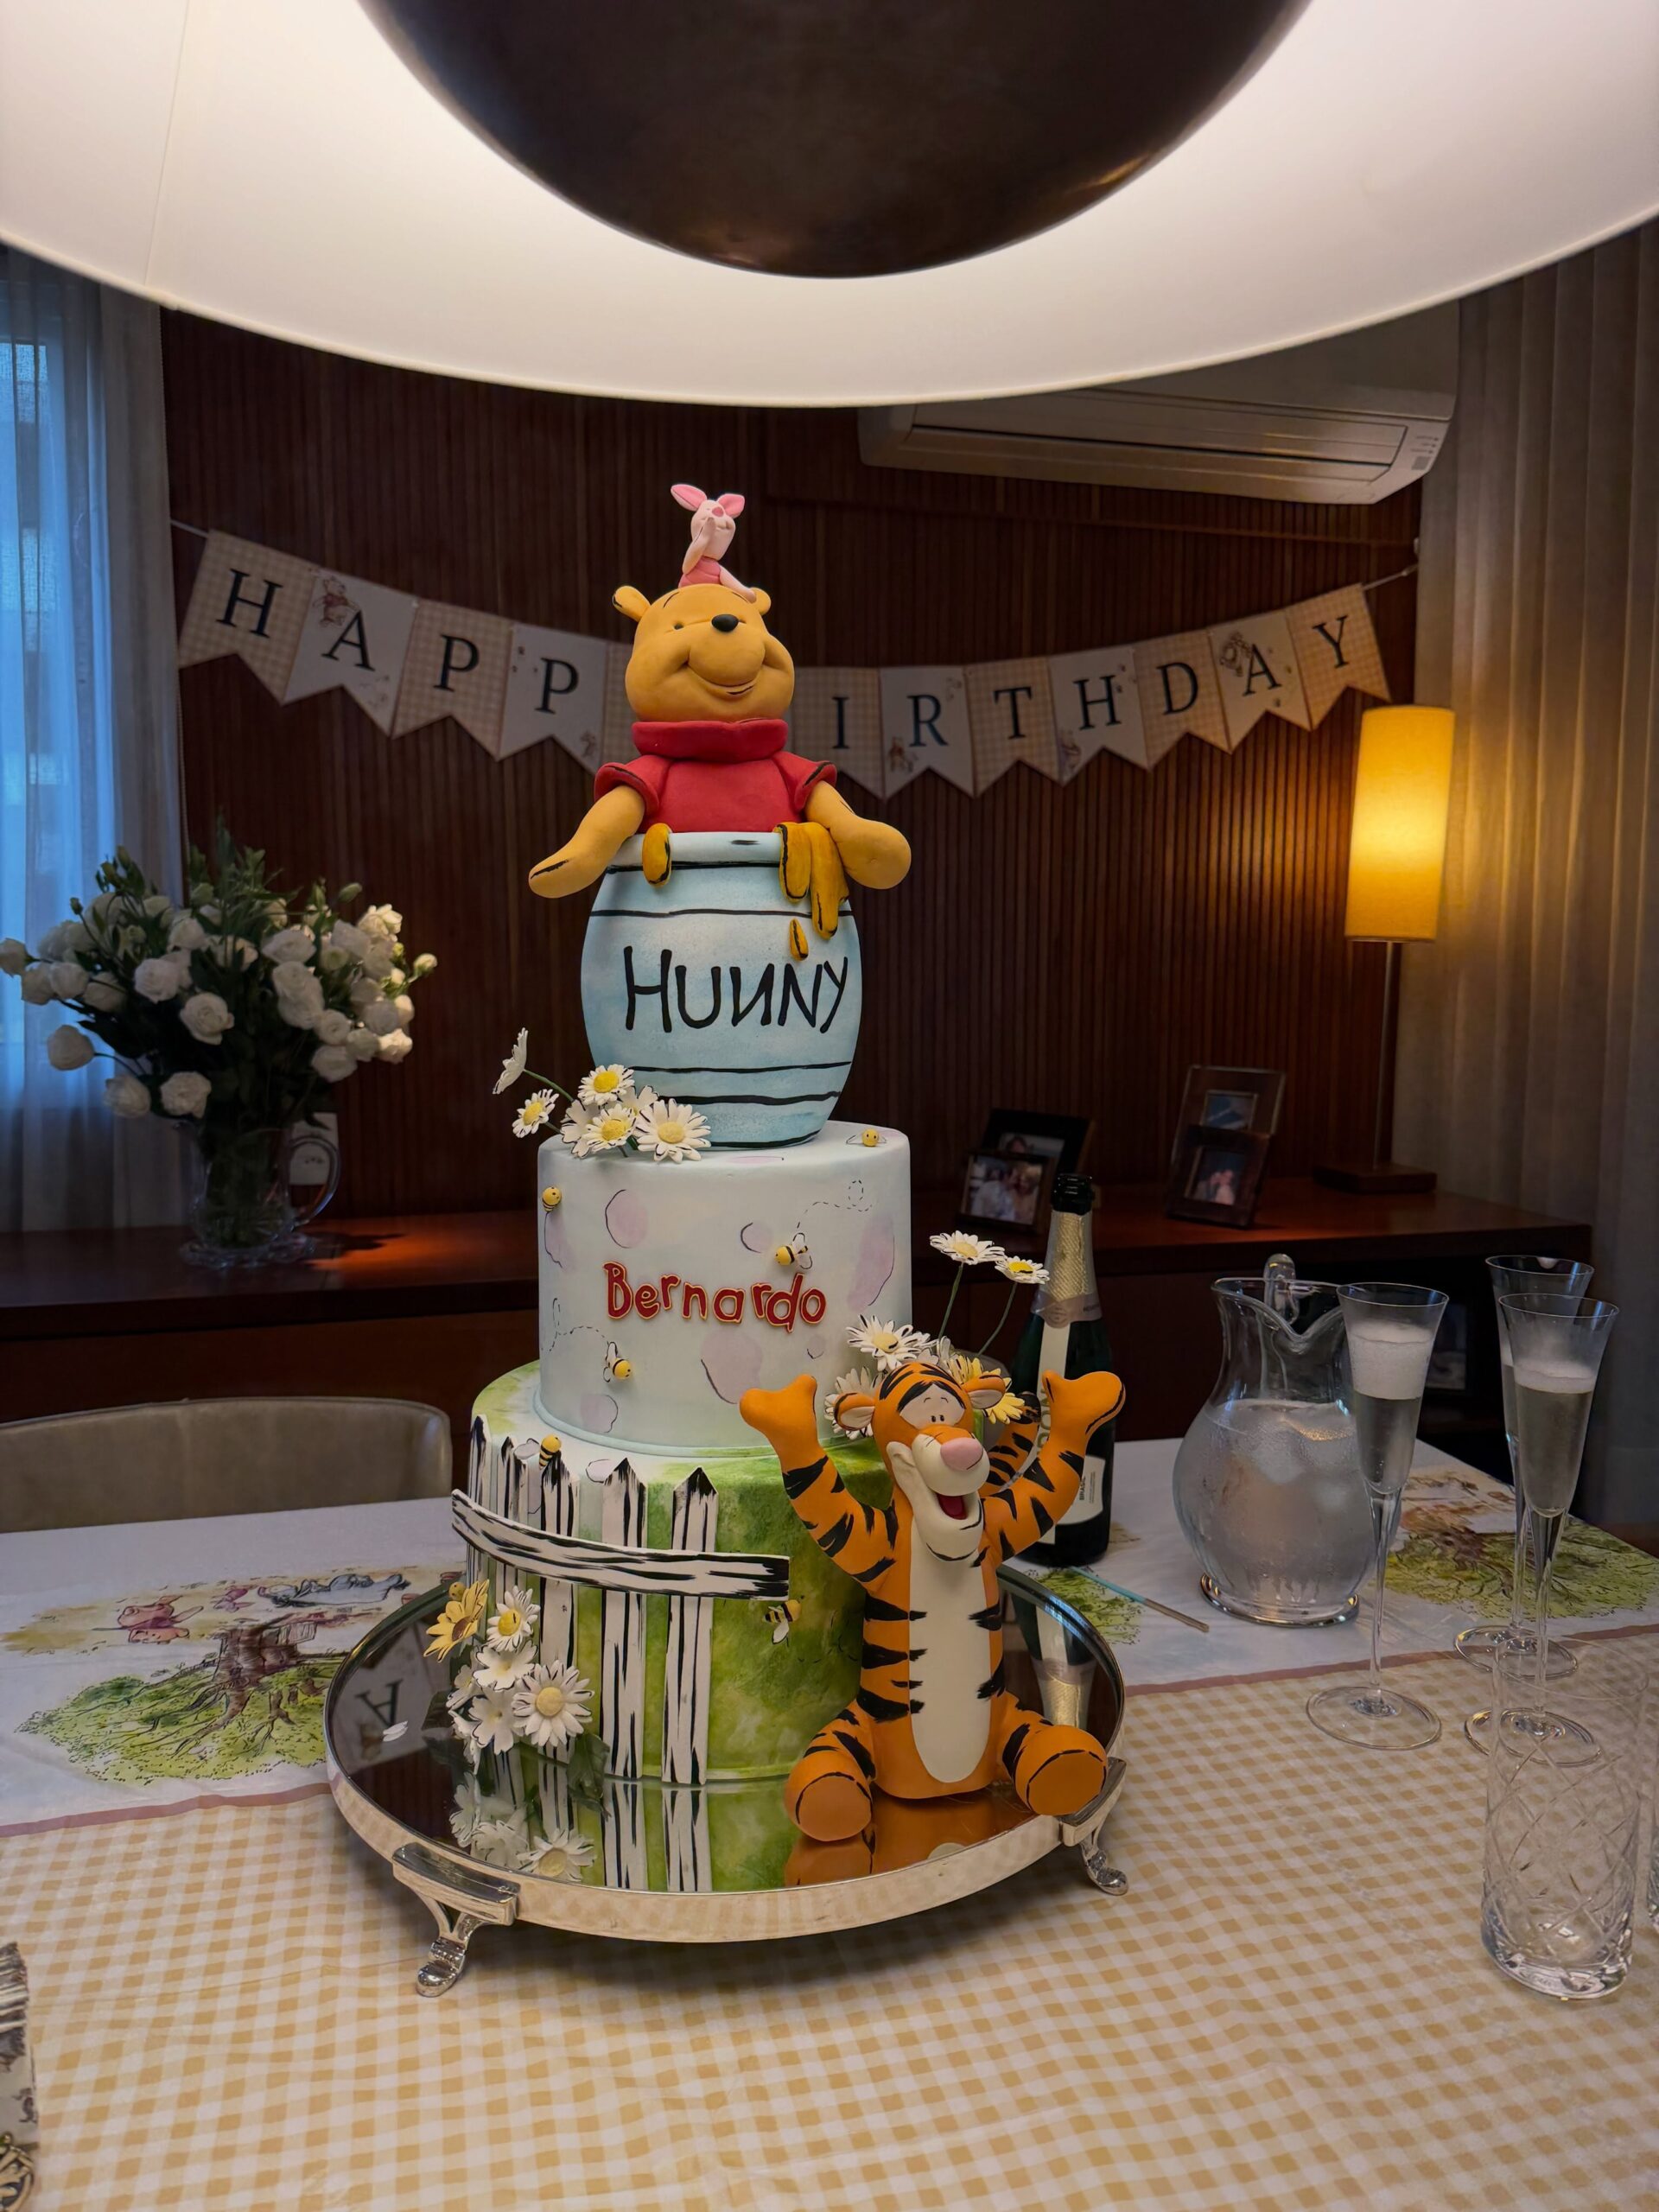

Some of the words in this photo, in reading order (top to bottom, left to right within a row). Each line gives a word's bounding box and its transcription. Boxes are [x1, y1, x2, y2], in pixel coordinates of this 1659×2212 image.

[215, 568, 578, 715] HAPP
[831, 615, 1349, 749] IRTHDAY
[623, 945, 849, 1033] HUNNY
[603, 1260, 827, 1332] Bernardo
